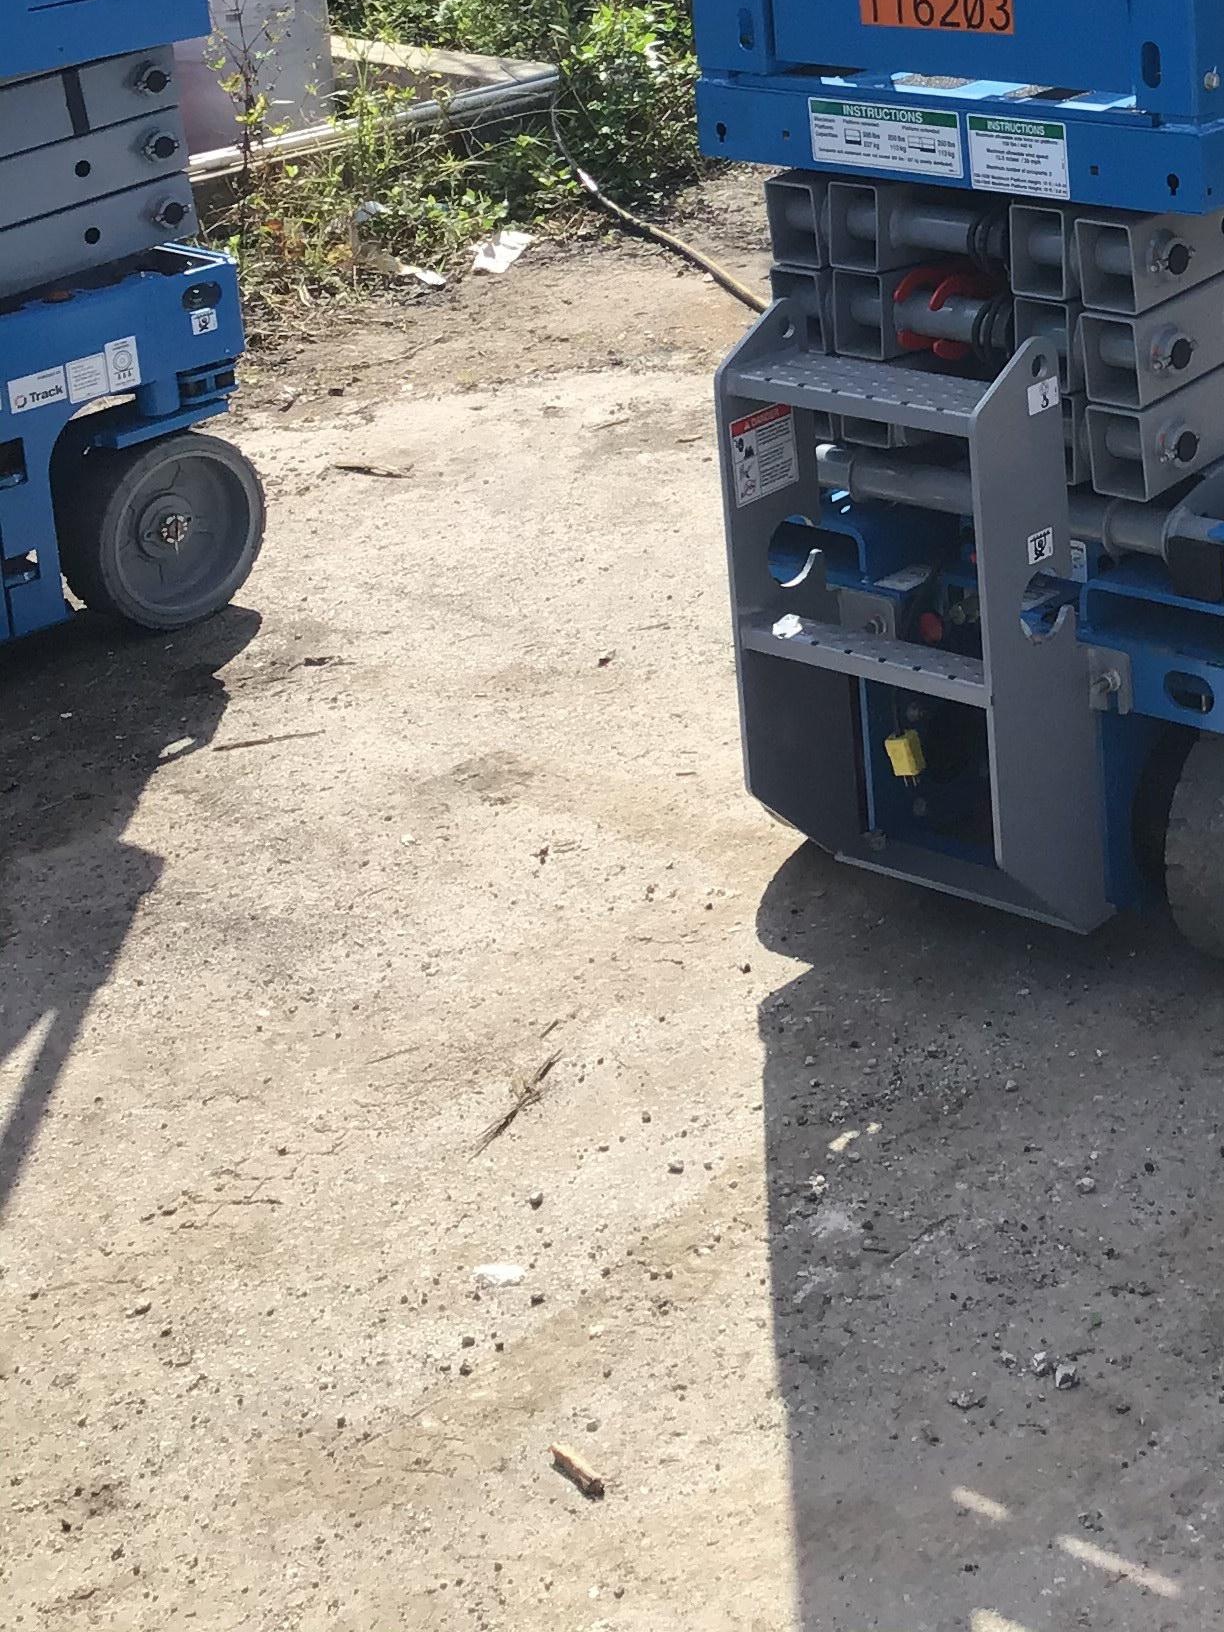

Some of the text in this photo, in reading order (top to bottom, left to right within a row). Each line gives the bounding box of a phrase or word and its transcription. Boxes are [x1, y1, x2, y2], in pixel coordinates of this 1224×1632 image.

[843, 104, 924, 123] INSTRUCTIONS
[986, 120, 1045, 136] INSTRUCTIONS
[29, 385, 63, 403] Track
